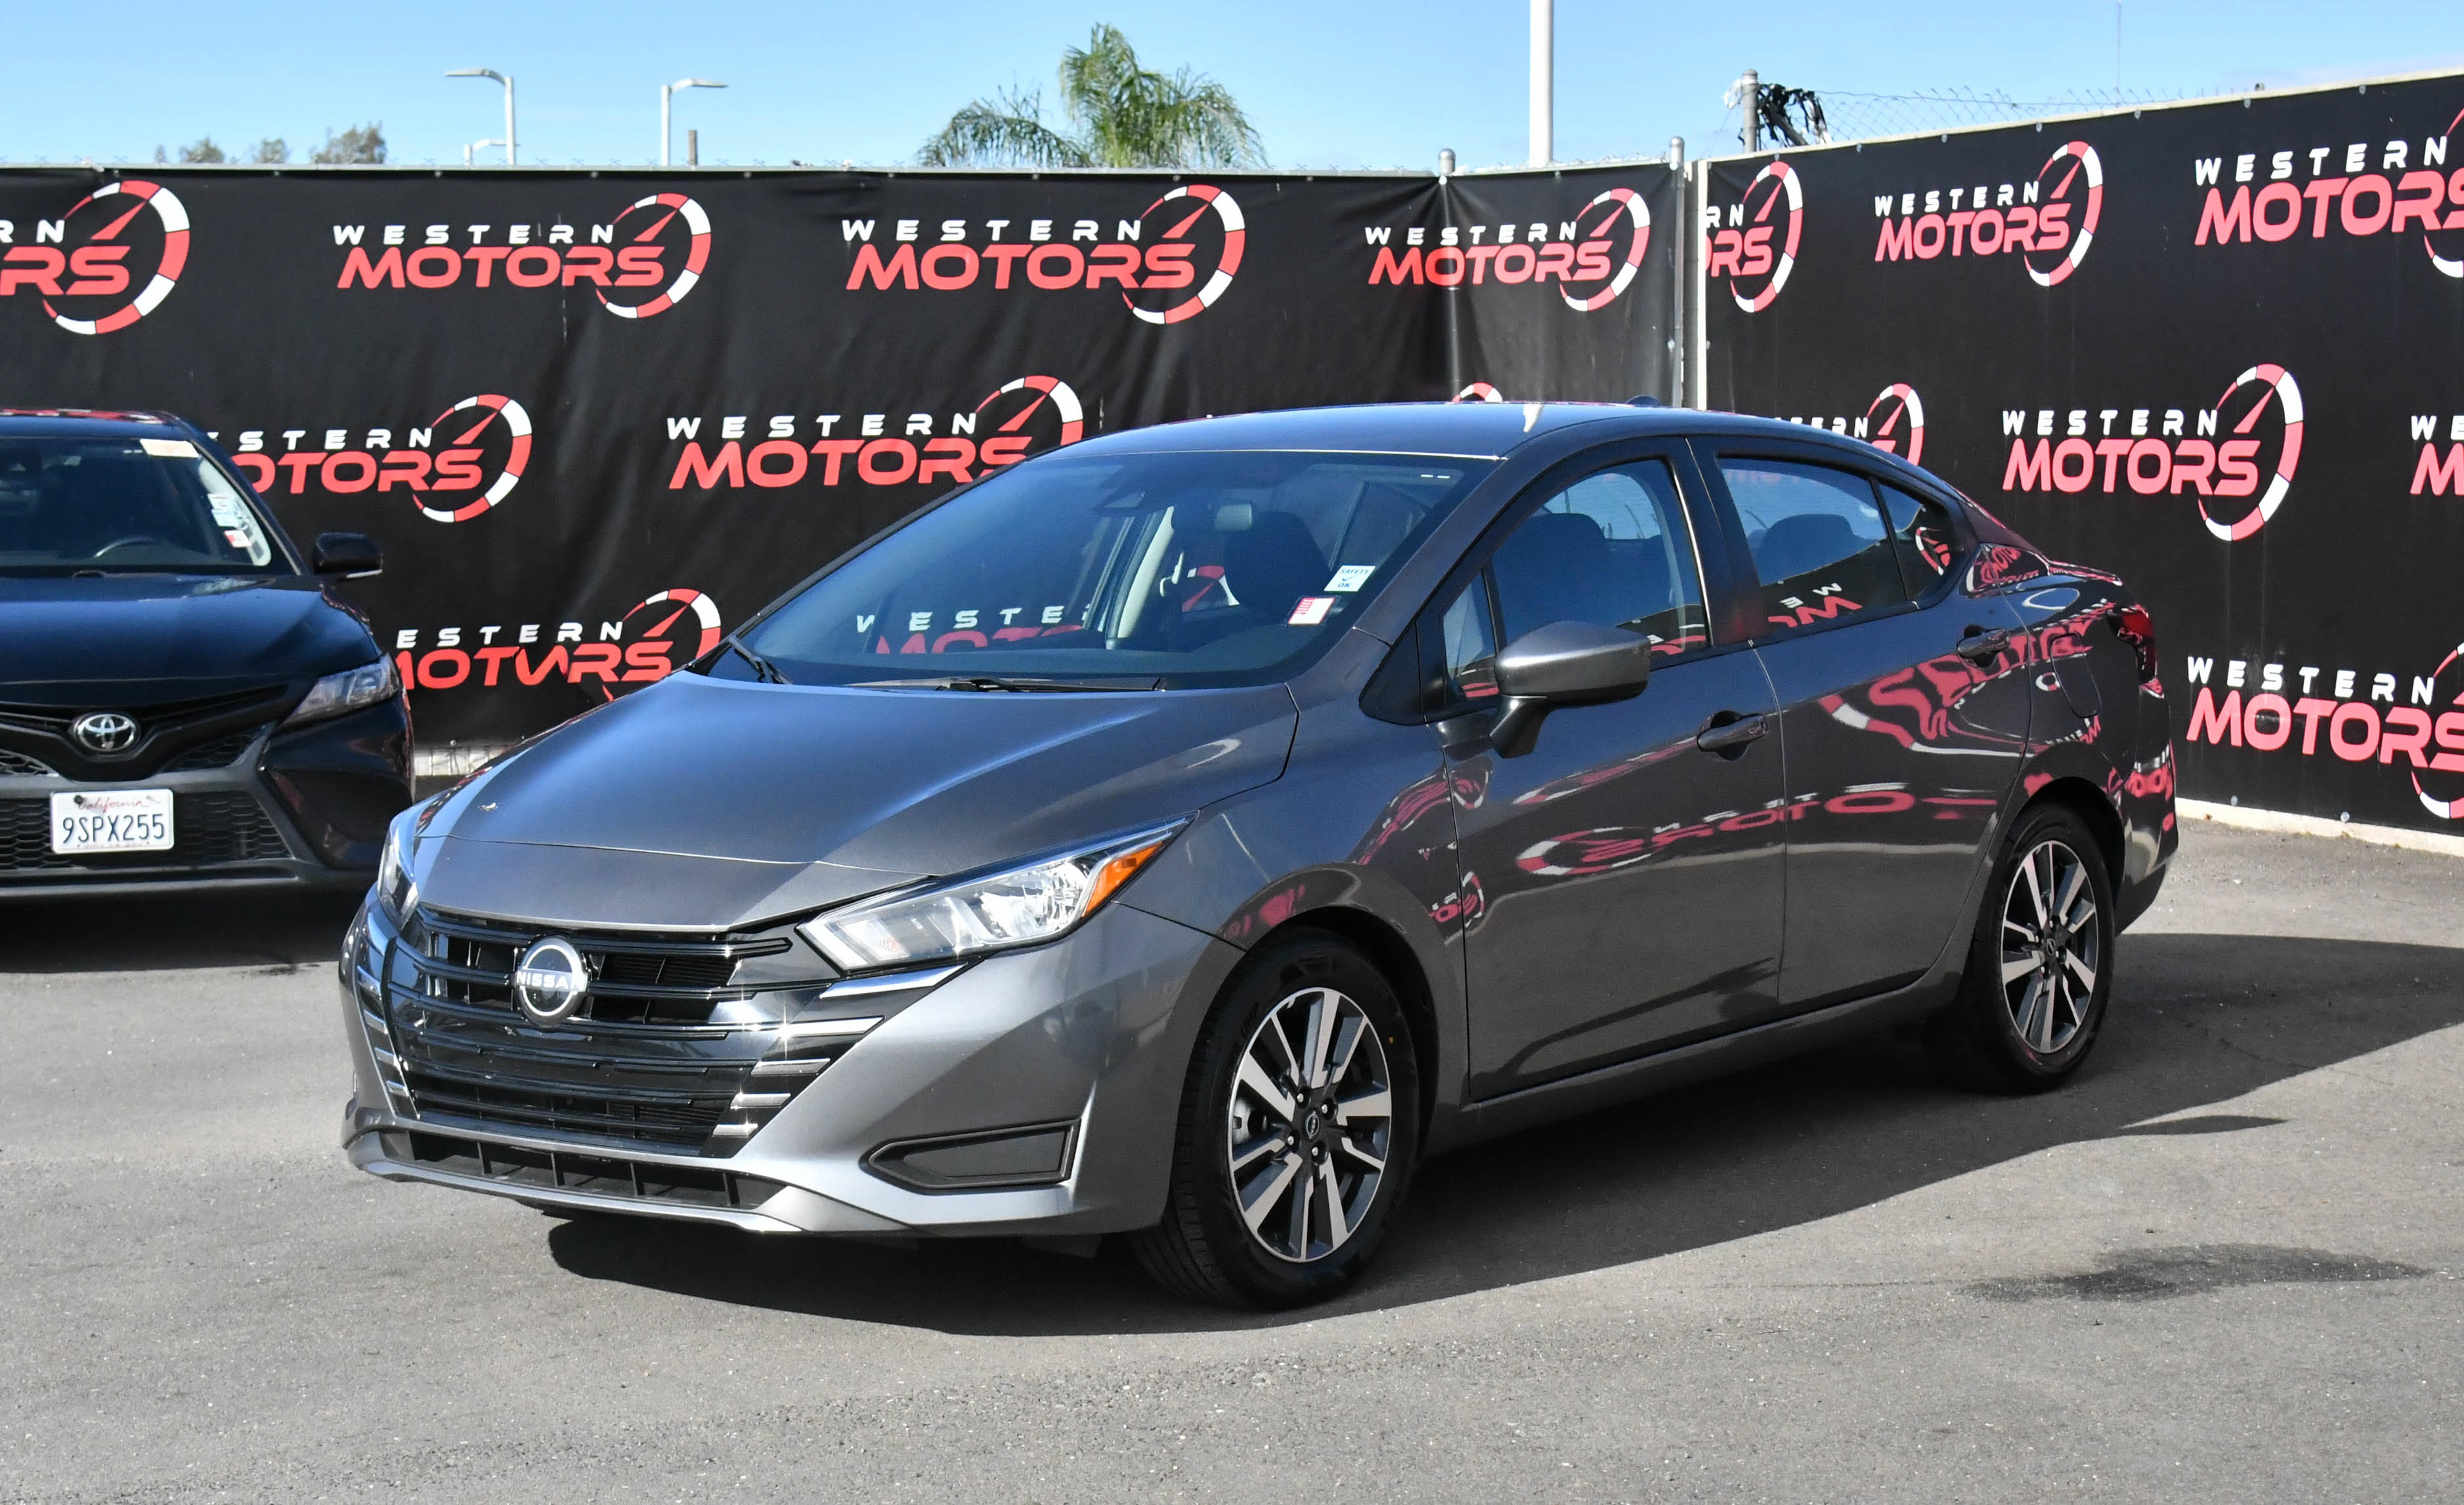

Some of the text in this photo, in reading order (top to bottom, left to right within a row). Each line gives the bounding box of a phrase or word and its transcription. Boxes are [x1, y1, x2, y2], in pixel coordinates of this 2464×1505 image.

[2195, 136, 2448, 186] WESTERN
[1874, 180, 2039, 217] WESTERN
[333, 224, 615, 245] WESTERN
[842, 219, 1141, 242] WESTERN
[1365, 221, 1577, 245] WESTERN
[1874, 203, 2071, 262] MOTORS
[337, 245, 665, 289] MOTORS
[846, 243, 1196, 291] MOTORS
[1368, 240, 1613, 286] MOTORS
[207, 427, 432, 452] STERN
[666, 412, 976, 440] WESTERN
[2002, 409, 2218, 436] WESTERN
[231, 448, 484, 494] OTORS
[668, 436, 1033, 490] MOTORS
[2002, 437, 2261, 497] MOTORS
[396, 621, 623, 648] ESTERN
[857, 605, 1088, 633] WESTE
[2187, 656, 2434, 706] WESTERN
[62, 813, 165, 844] 9SPX255
